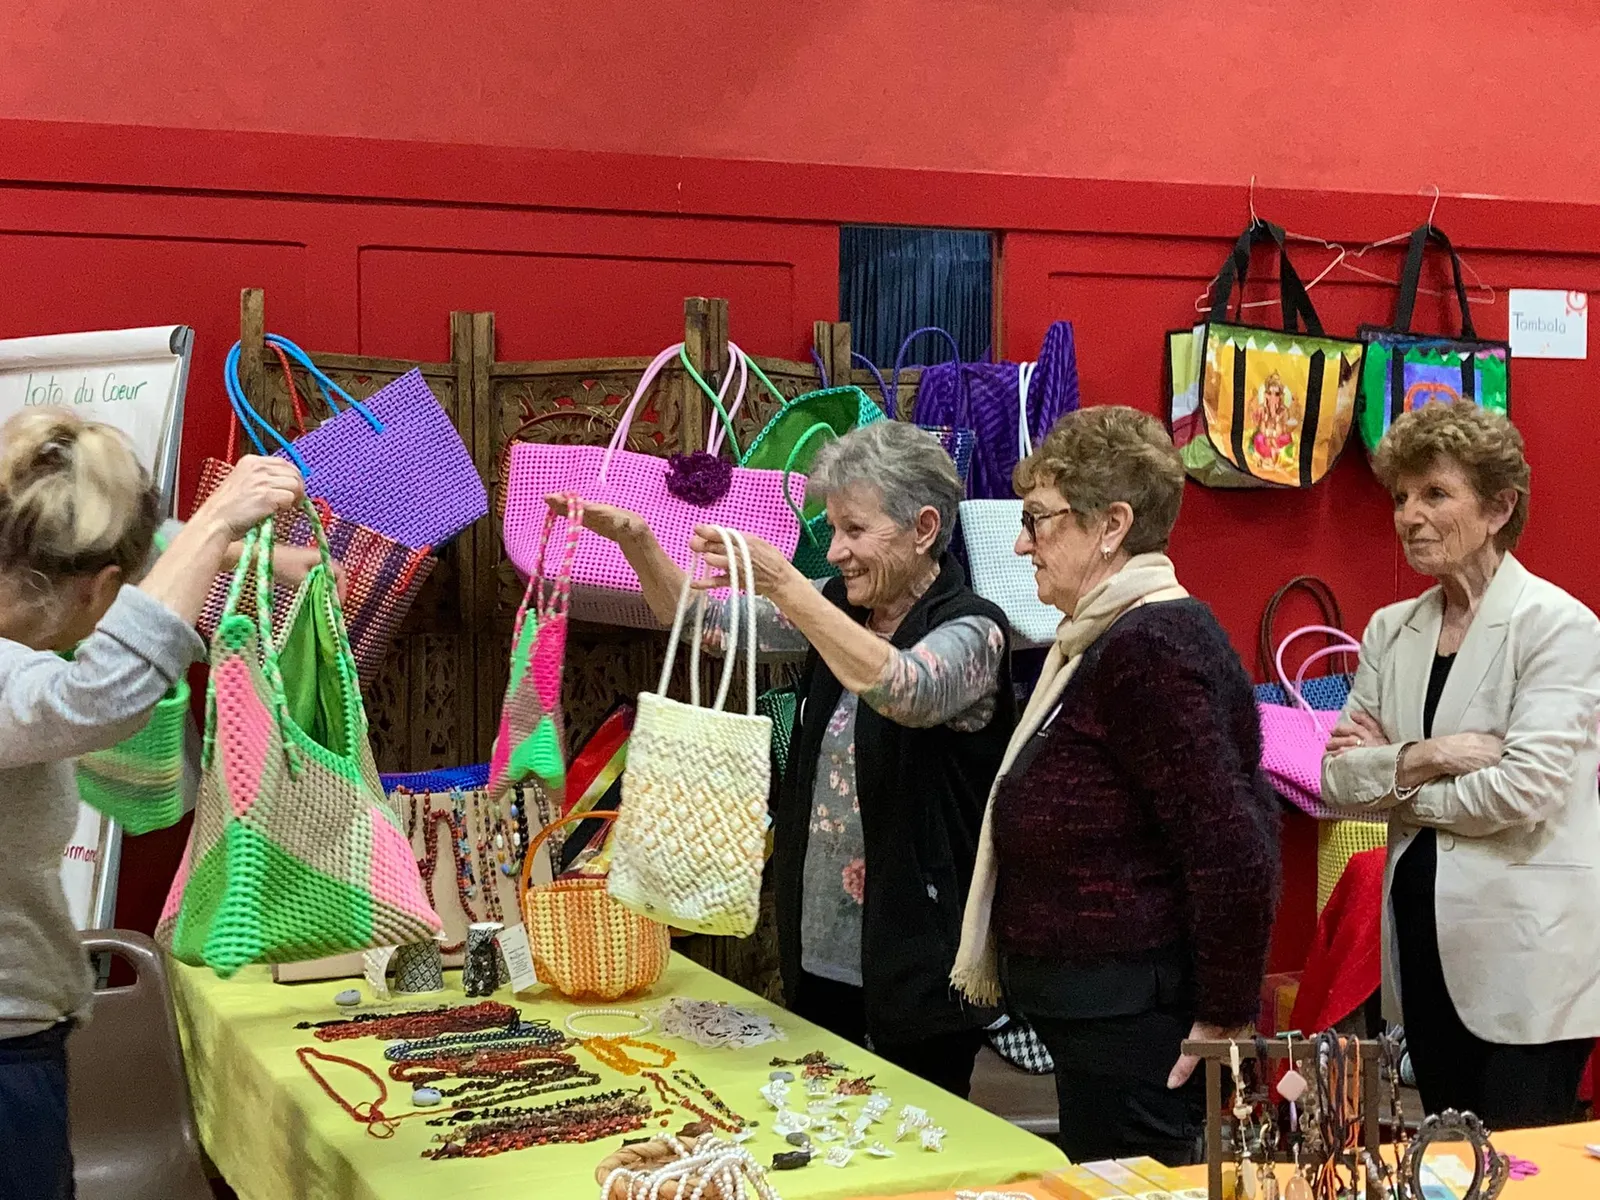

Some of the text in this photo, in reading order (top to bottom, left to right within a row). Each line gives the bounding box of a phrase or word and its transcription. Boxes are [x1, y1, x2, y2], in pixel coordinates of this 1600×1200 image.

[1512, 311, 1566, 335] Tombola
[24, 372, 147, 407] Loto du Coeur
